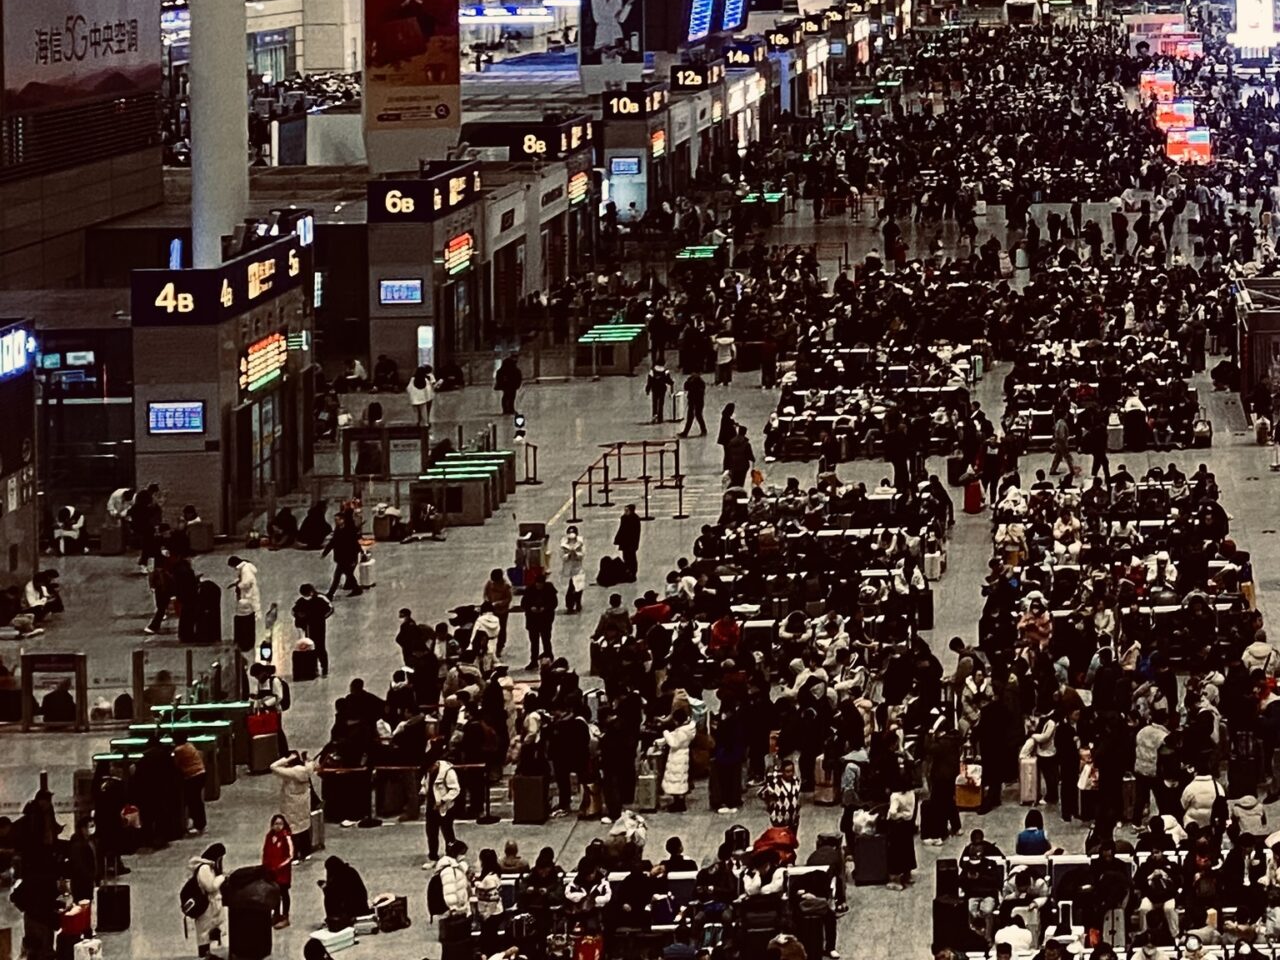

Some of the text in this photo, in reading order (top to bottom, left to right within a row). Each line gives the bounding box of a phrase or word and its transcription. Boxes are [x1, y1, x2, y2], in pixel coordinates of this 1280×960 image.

[34, 14, 138, 65] 海信5G中央空调
[610, 98, 640, 114] 10B
[523, 135, 546, 154] 8B
[385, 190, 414, 214] 6B
[154, 282, 194, 313] 4B
